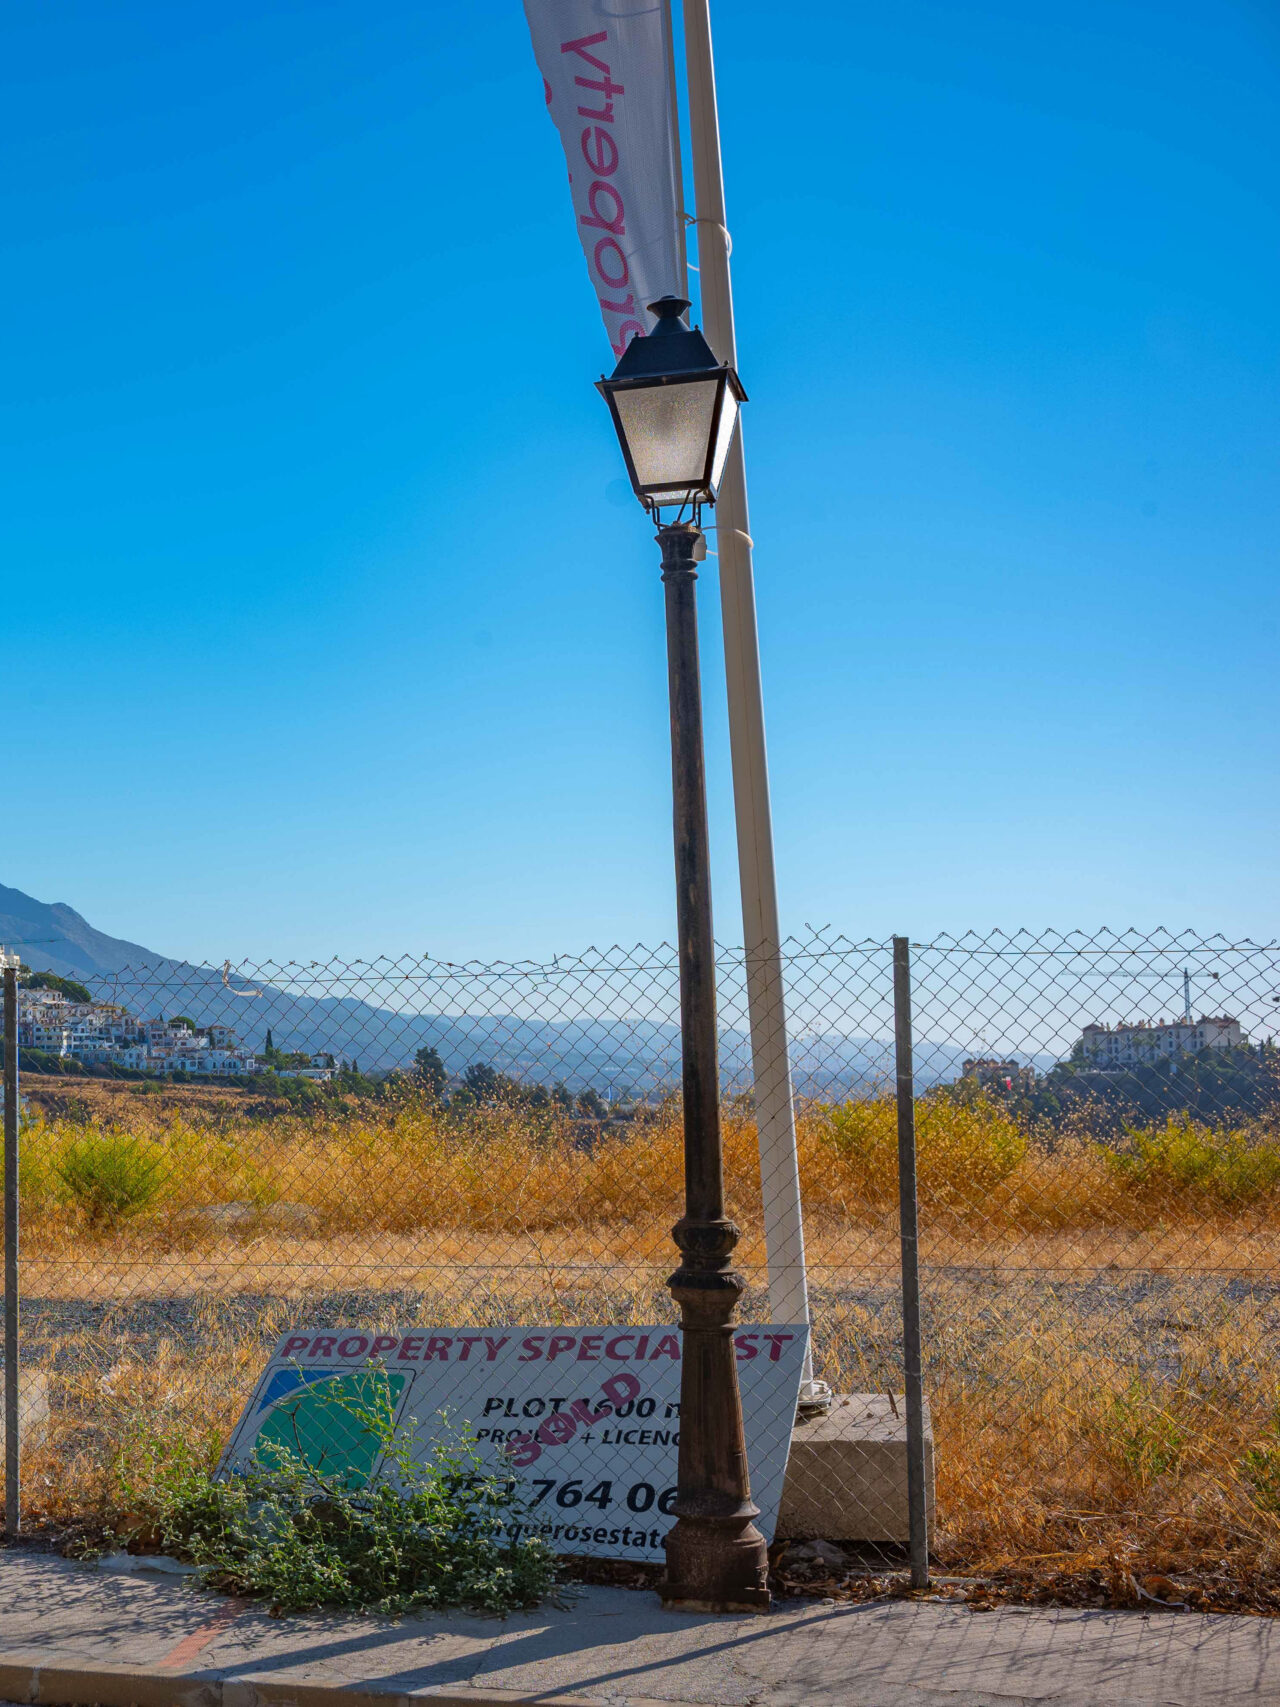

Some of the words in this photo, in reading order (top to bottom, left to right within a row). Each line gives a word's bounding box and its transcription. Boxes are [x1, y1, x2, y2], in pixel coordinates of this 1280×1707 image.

[280, 1335, 511, 1362] PROPERTY
[517, 1334, 793, 1363] SPECIAST
[482, 1397, 567, 1419] PLOT
[505, 1373, 641, 1468] SOLD
[477, 1428, 570, 1445] PROE
[581, 1431, 596, 1444] +
[528, 1478, 613, 1508] 764
